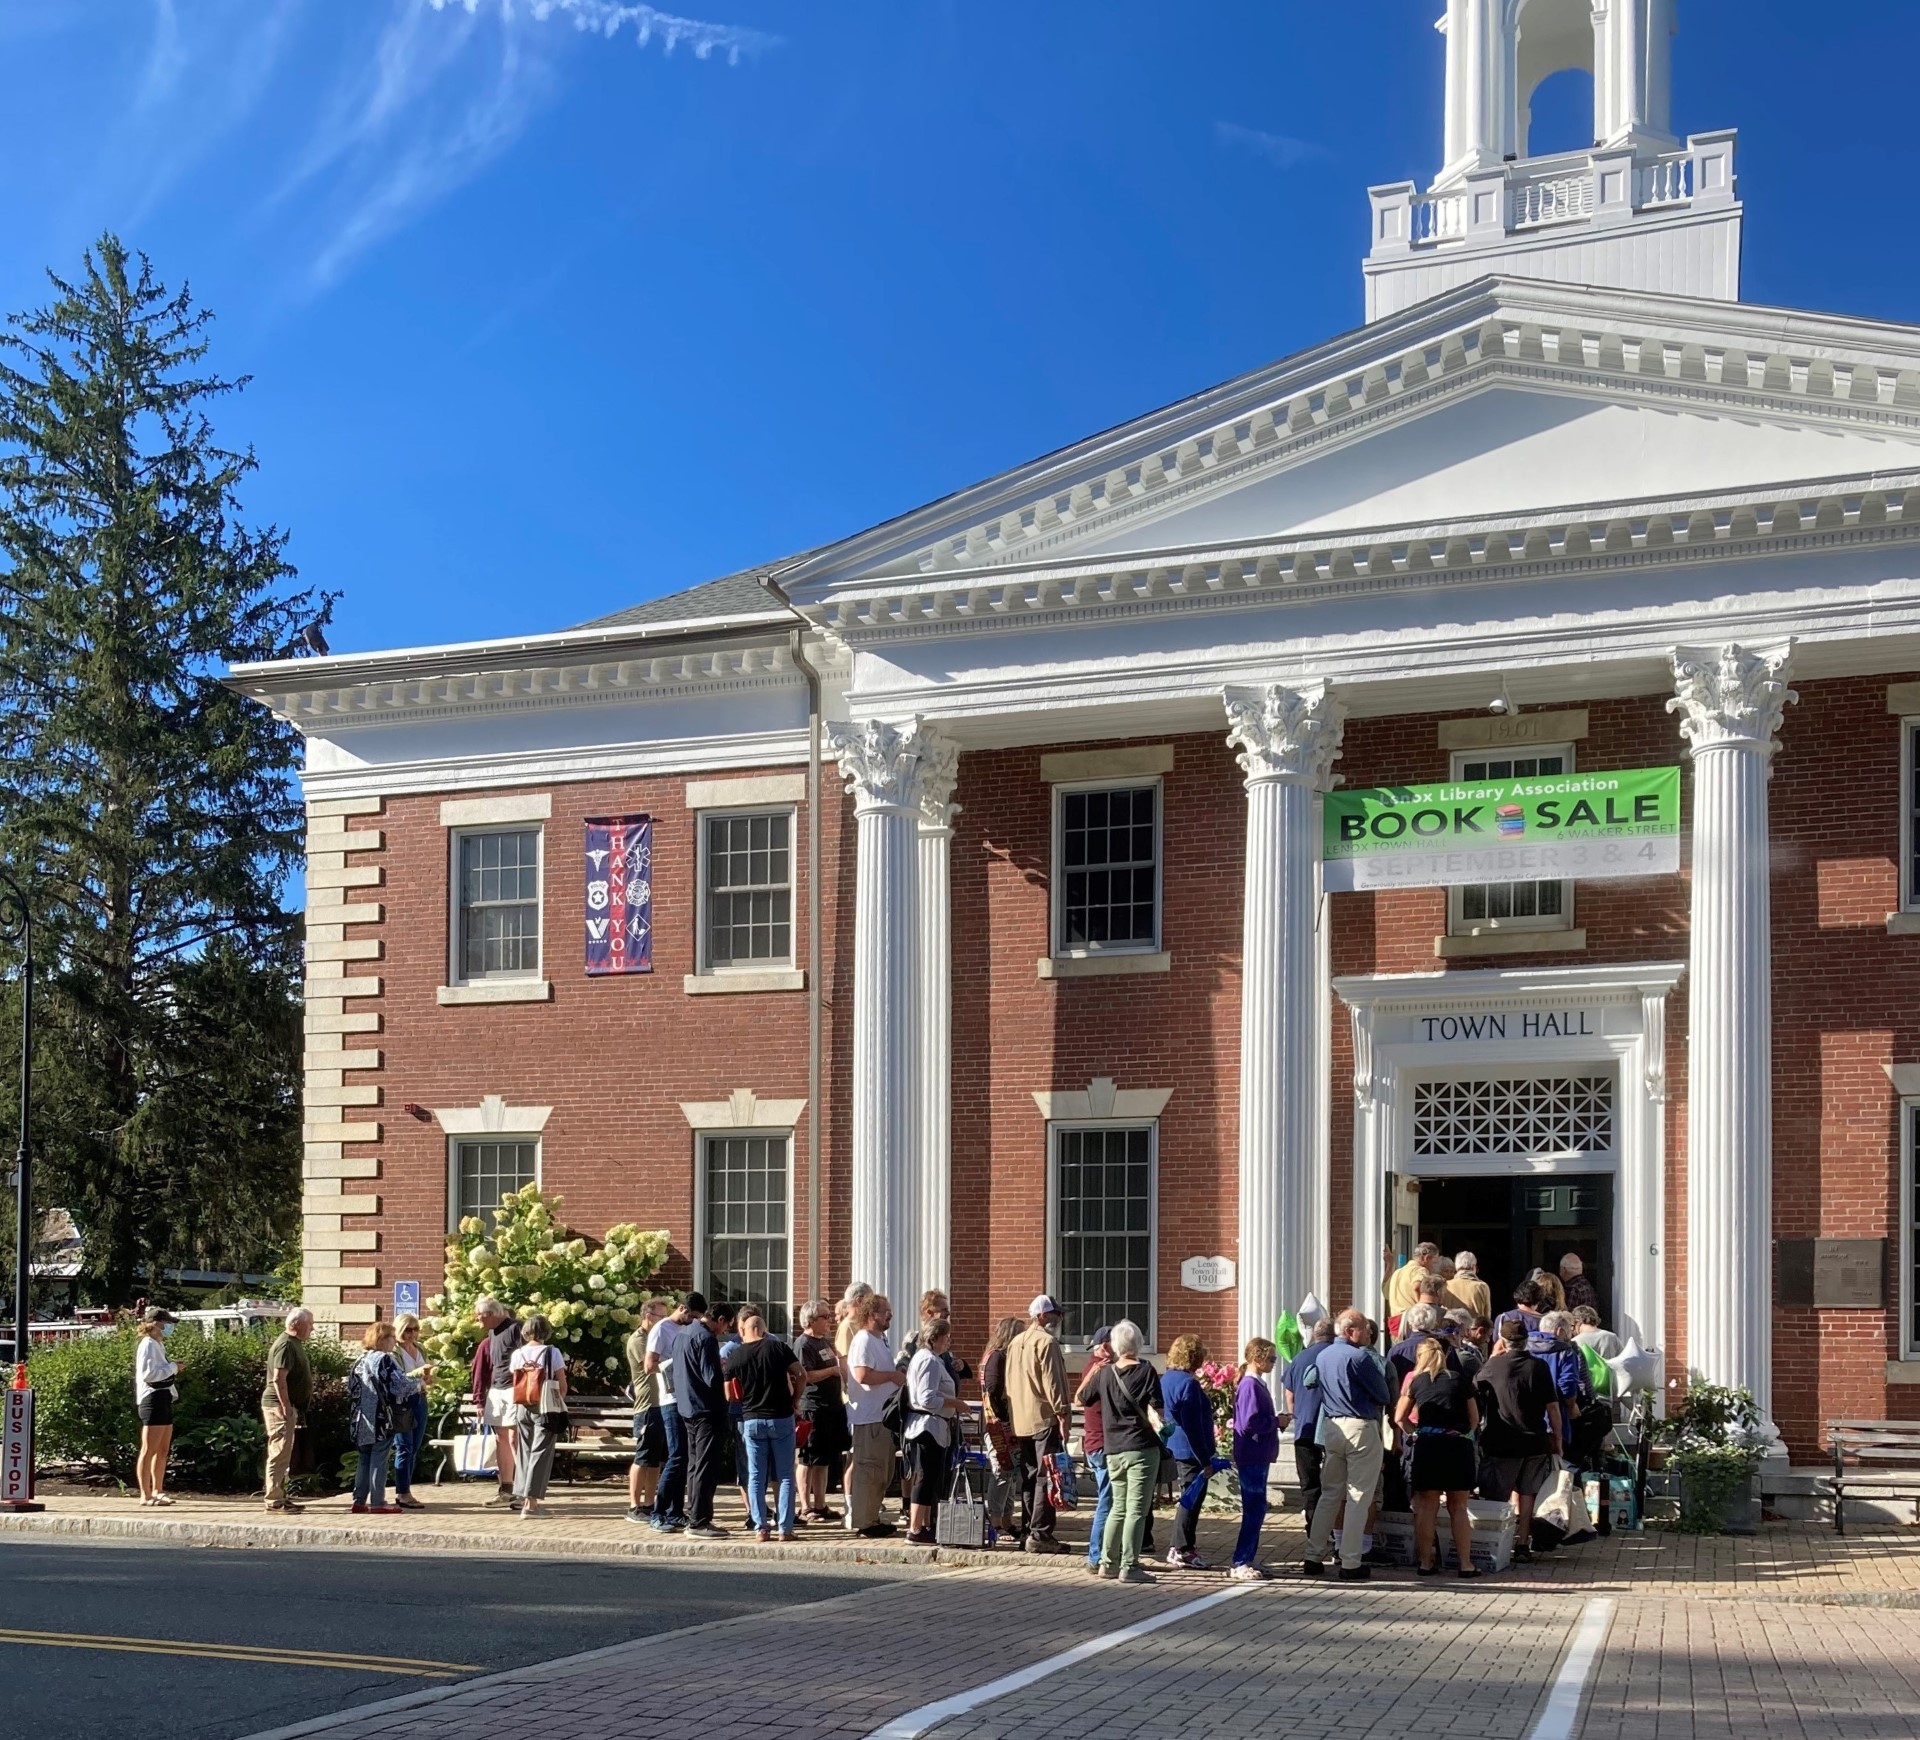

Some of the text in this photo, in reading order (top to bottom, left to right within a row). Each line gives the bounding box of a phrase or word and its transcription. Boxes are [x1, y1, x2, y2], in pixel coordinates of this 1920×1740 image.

[1487, 721, 1538, 740] 1901
[1379, 778, 1619, 806] Lenox Library Association
[1341, 794, 1660, 841] BOOK SALE
[1557, 824, 1676, 840] 6 WALKER STREET
[1326, 838, 1447, 855] LENOX TOWN HALL
[1367, 849, 1559, 876] SEPTEMBER
[1572, 846, 1588, 865] 3
[1602, 844, 1623, 863] &
[1637, 841, 1656, 861] 4
[610, 819, 625, 970] THANK YOU
[1421, 1011, 1594, 1041] TOWN HALL
[1649, 1243, 1659, 1256] 6
[1191, 1267, 1227, 1275] Town Hall
[1198, 1274, 1218, 1284] 1901
[8, 1394, 24, 1495] BUS STOP
